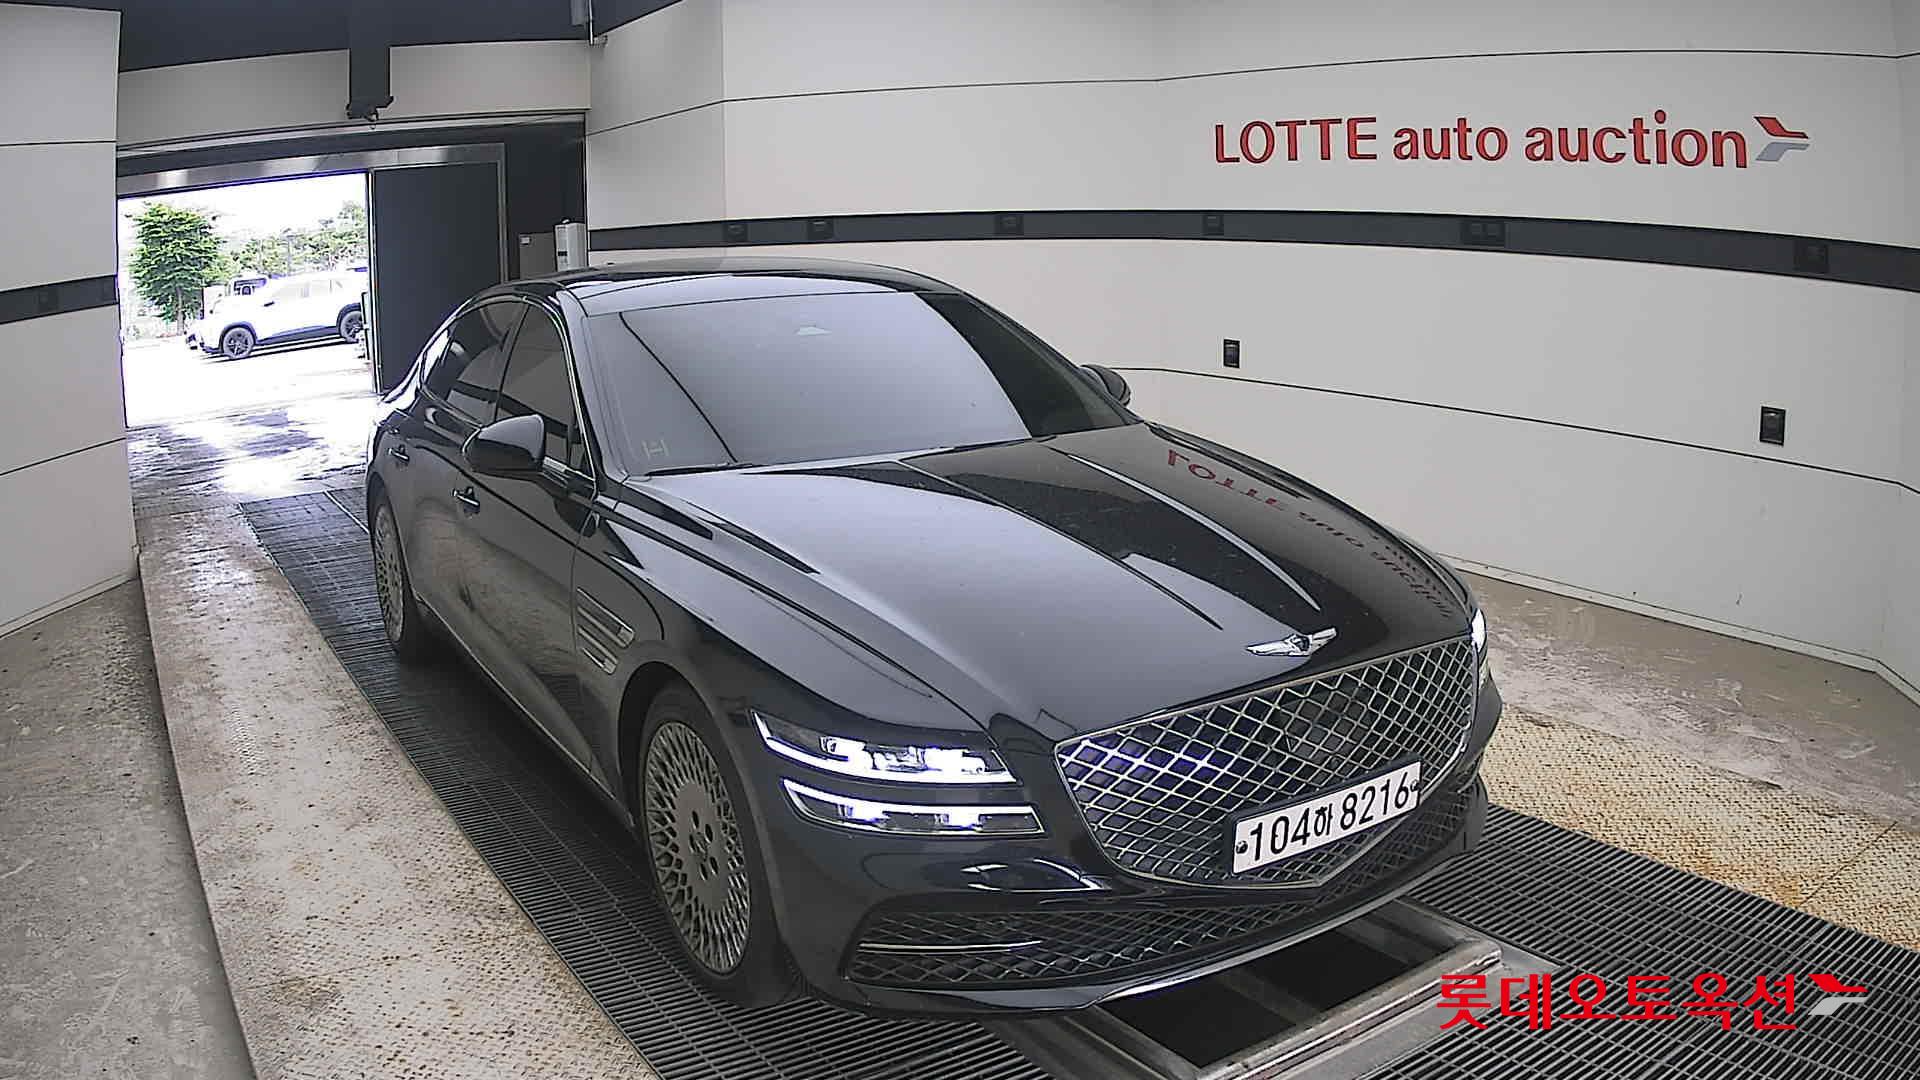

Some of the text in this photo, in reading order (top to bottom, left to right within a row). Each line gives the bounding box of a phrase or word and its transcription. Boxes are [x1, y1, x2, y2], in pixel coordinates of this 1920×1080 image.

[1215, 110, 1749, 168] LOTTE auto auction
[1250, 772, 1409, 861] 104하 8216
